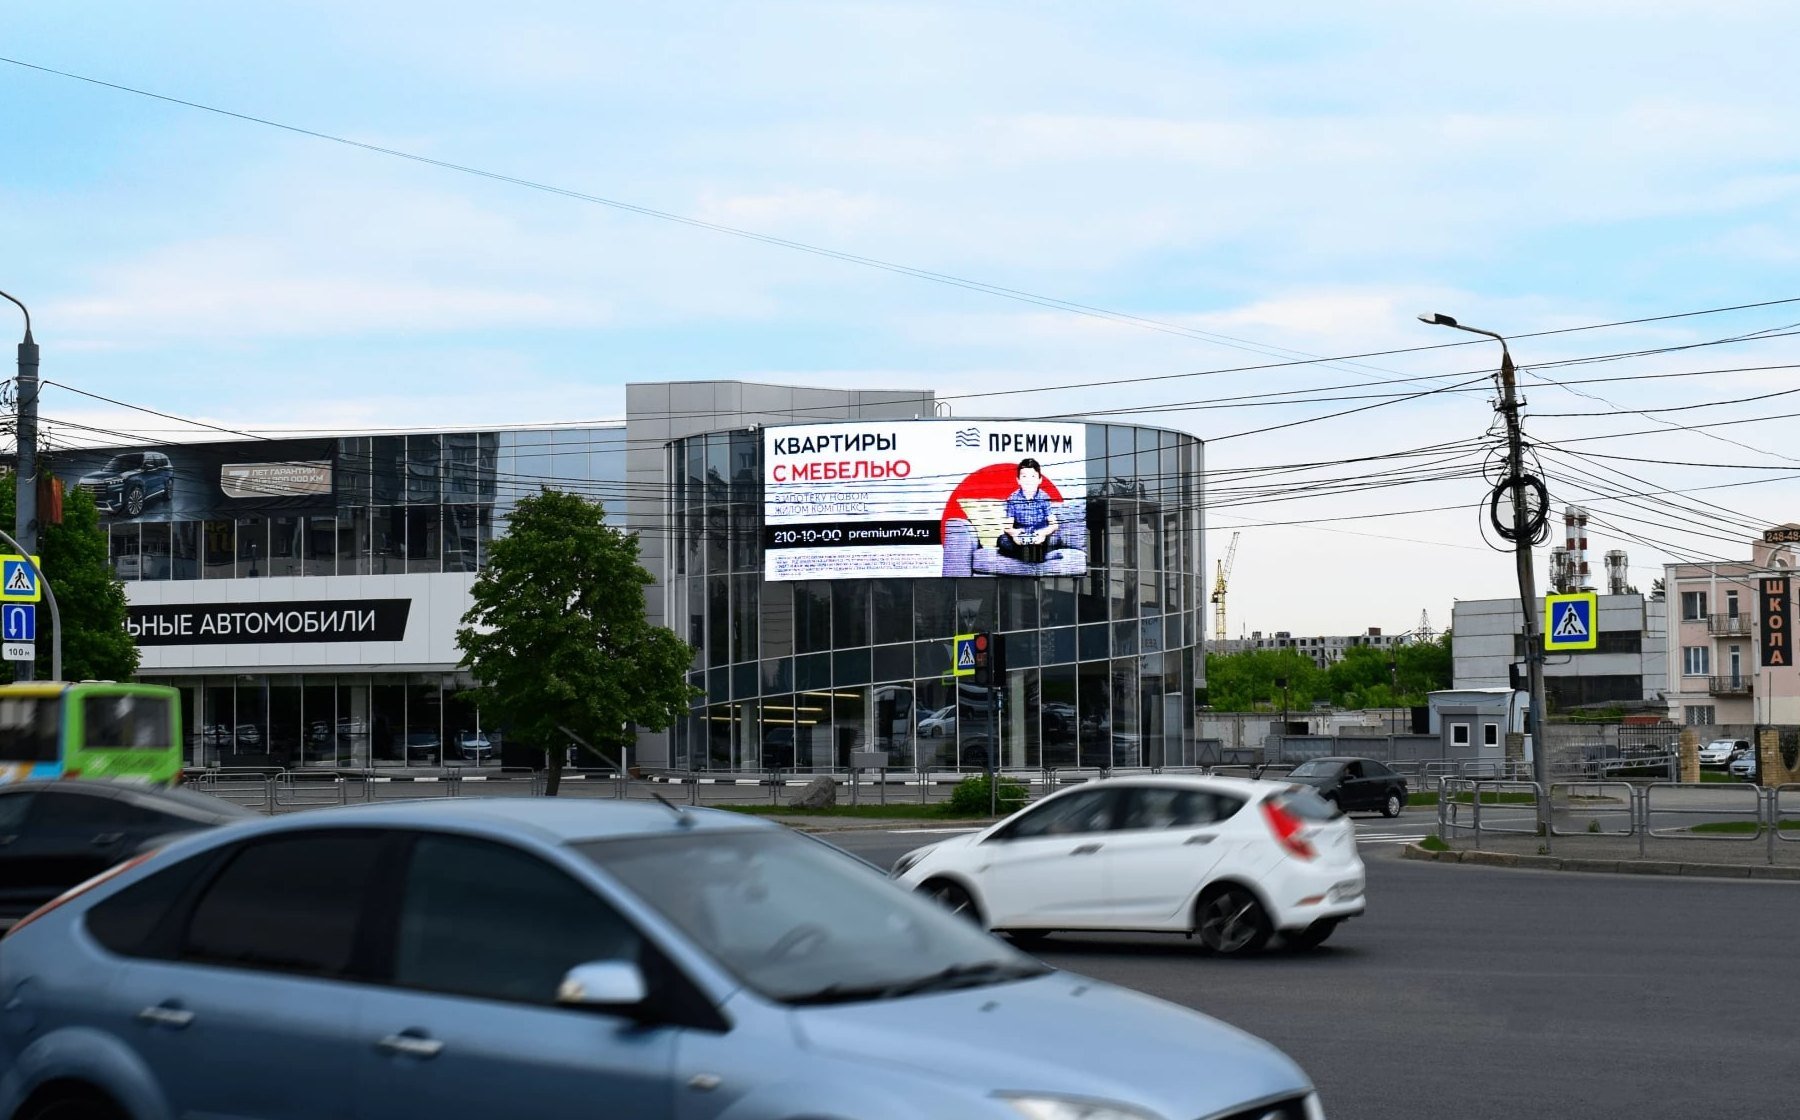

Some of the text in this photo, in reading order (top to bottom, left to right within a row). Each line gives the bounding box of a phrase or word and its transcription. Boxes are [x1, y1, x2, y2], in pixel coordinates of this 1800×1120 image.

[774, 433, 896, 455] КВАРТИРЫ
[989, 433, 1072, 453] ПРЕМИУМ
[270, 467, 316, 475] ГАРАНТИИ
[773, 460, 911, 482] С МЕБЕЛЬЮ
[830, 492, 869, 501] НОВОМ
[775, 503, 869, 514] ЖИЛОМ КОМПЛЕКСЕ
[774, 527, 930, 543] 210-10-00 premium74.ru
[122, 610, 375, 637] ЬНЫЕ АВТОМОБИЛИ
[1766, 580, 1784, 664] ШКОЛА
[9, 648, 24, 656] 100
